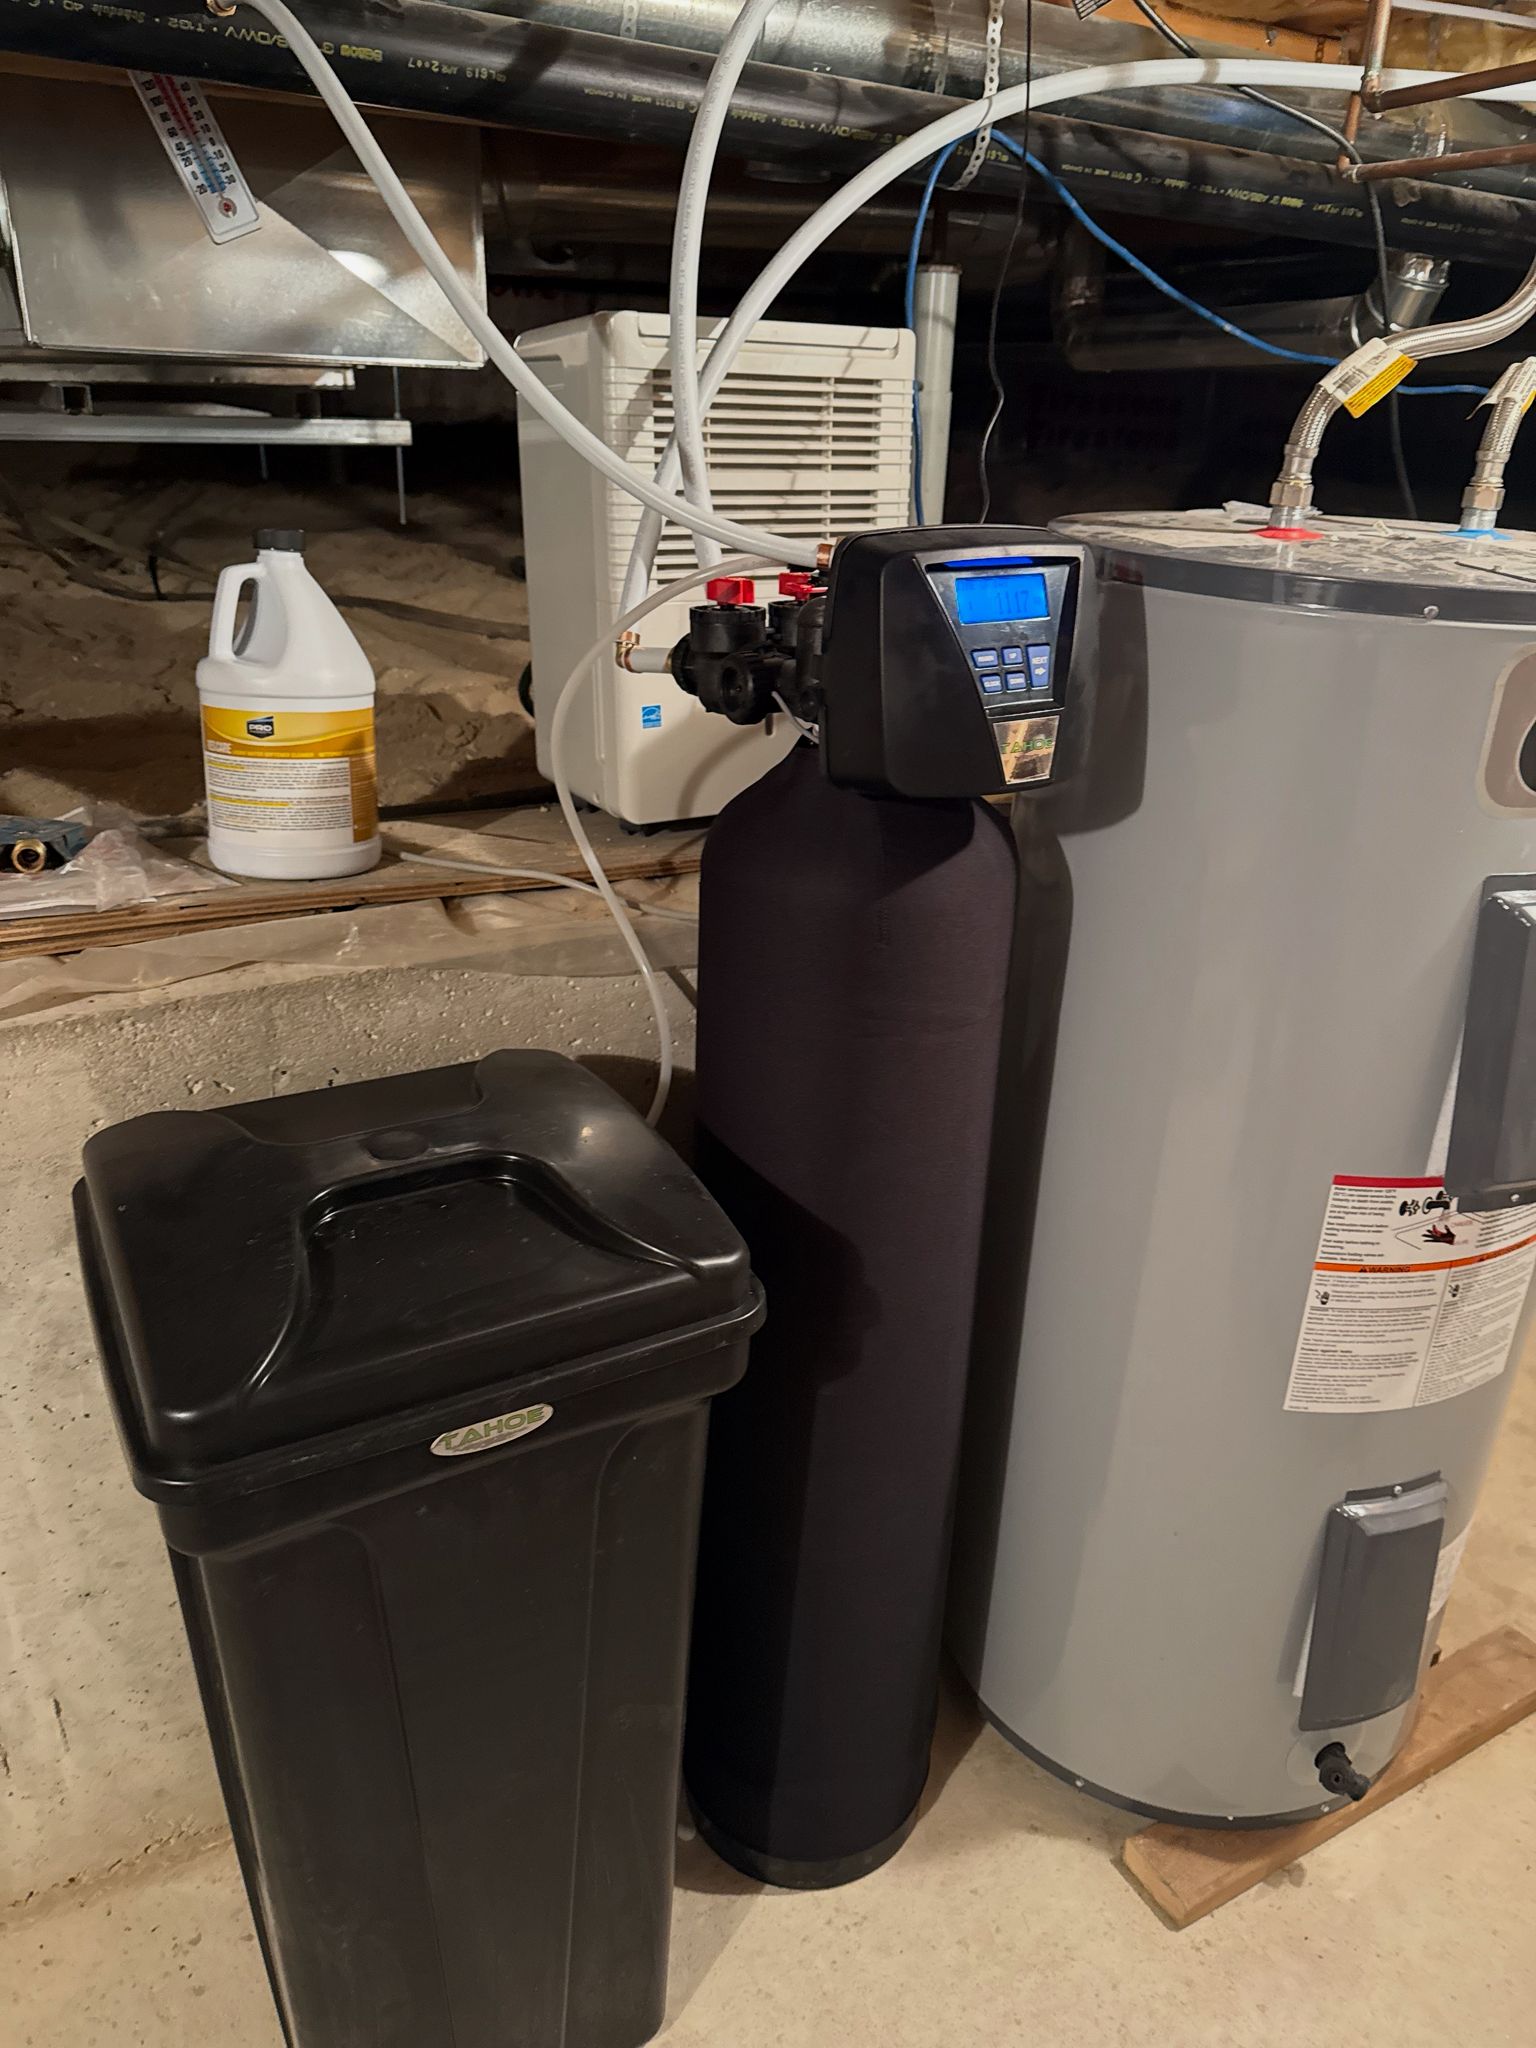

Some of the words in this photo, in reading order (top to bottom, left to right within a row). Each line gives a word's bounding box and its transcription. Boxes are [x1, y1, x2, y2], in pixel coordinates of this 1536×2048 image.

[248, 723, 273, 732] PRO
[1000, 737, 1054, 755] TAHOE
[441, 1406, 546, 1451] TAHOE
